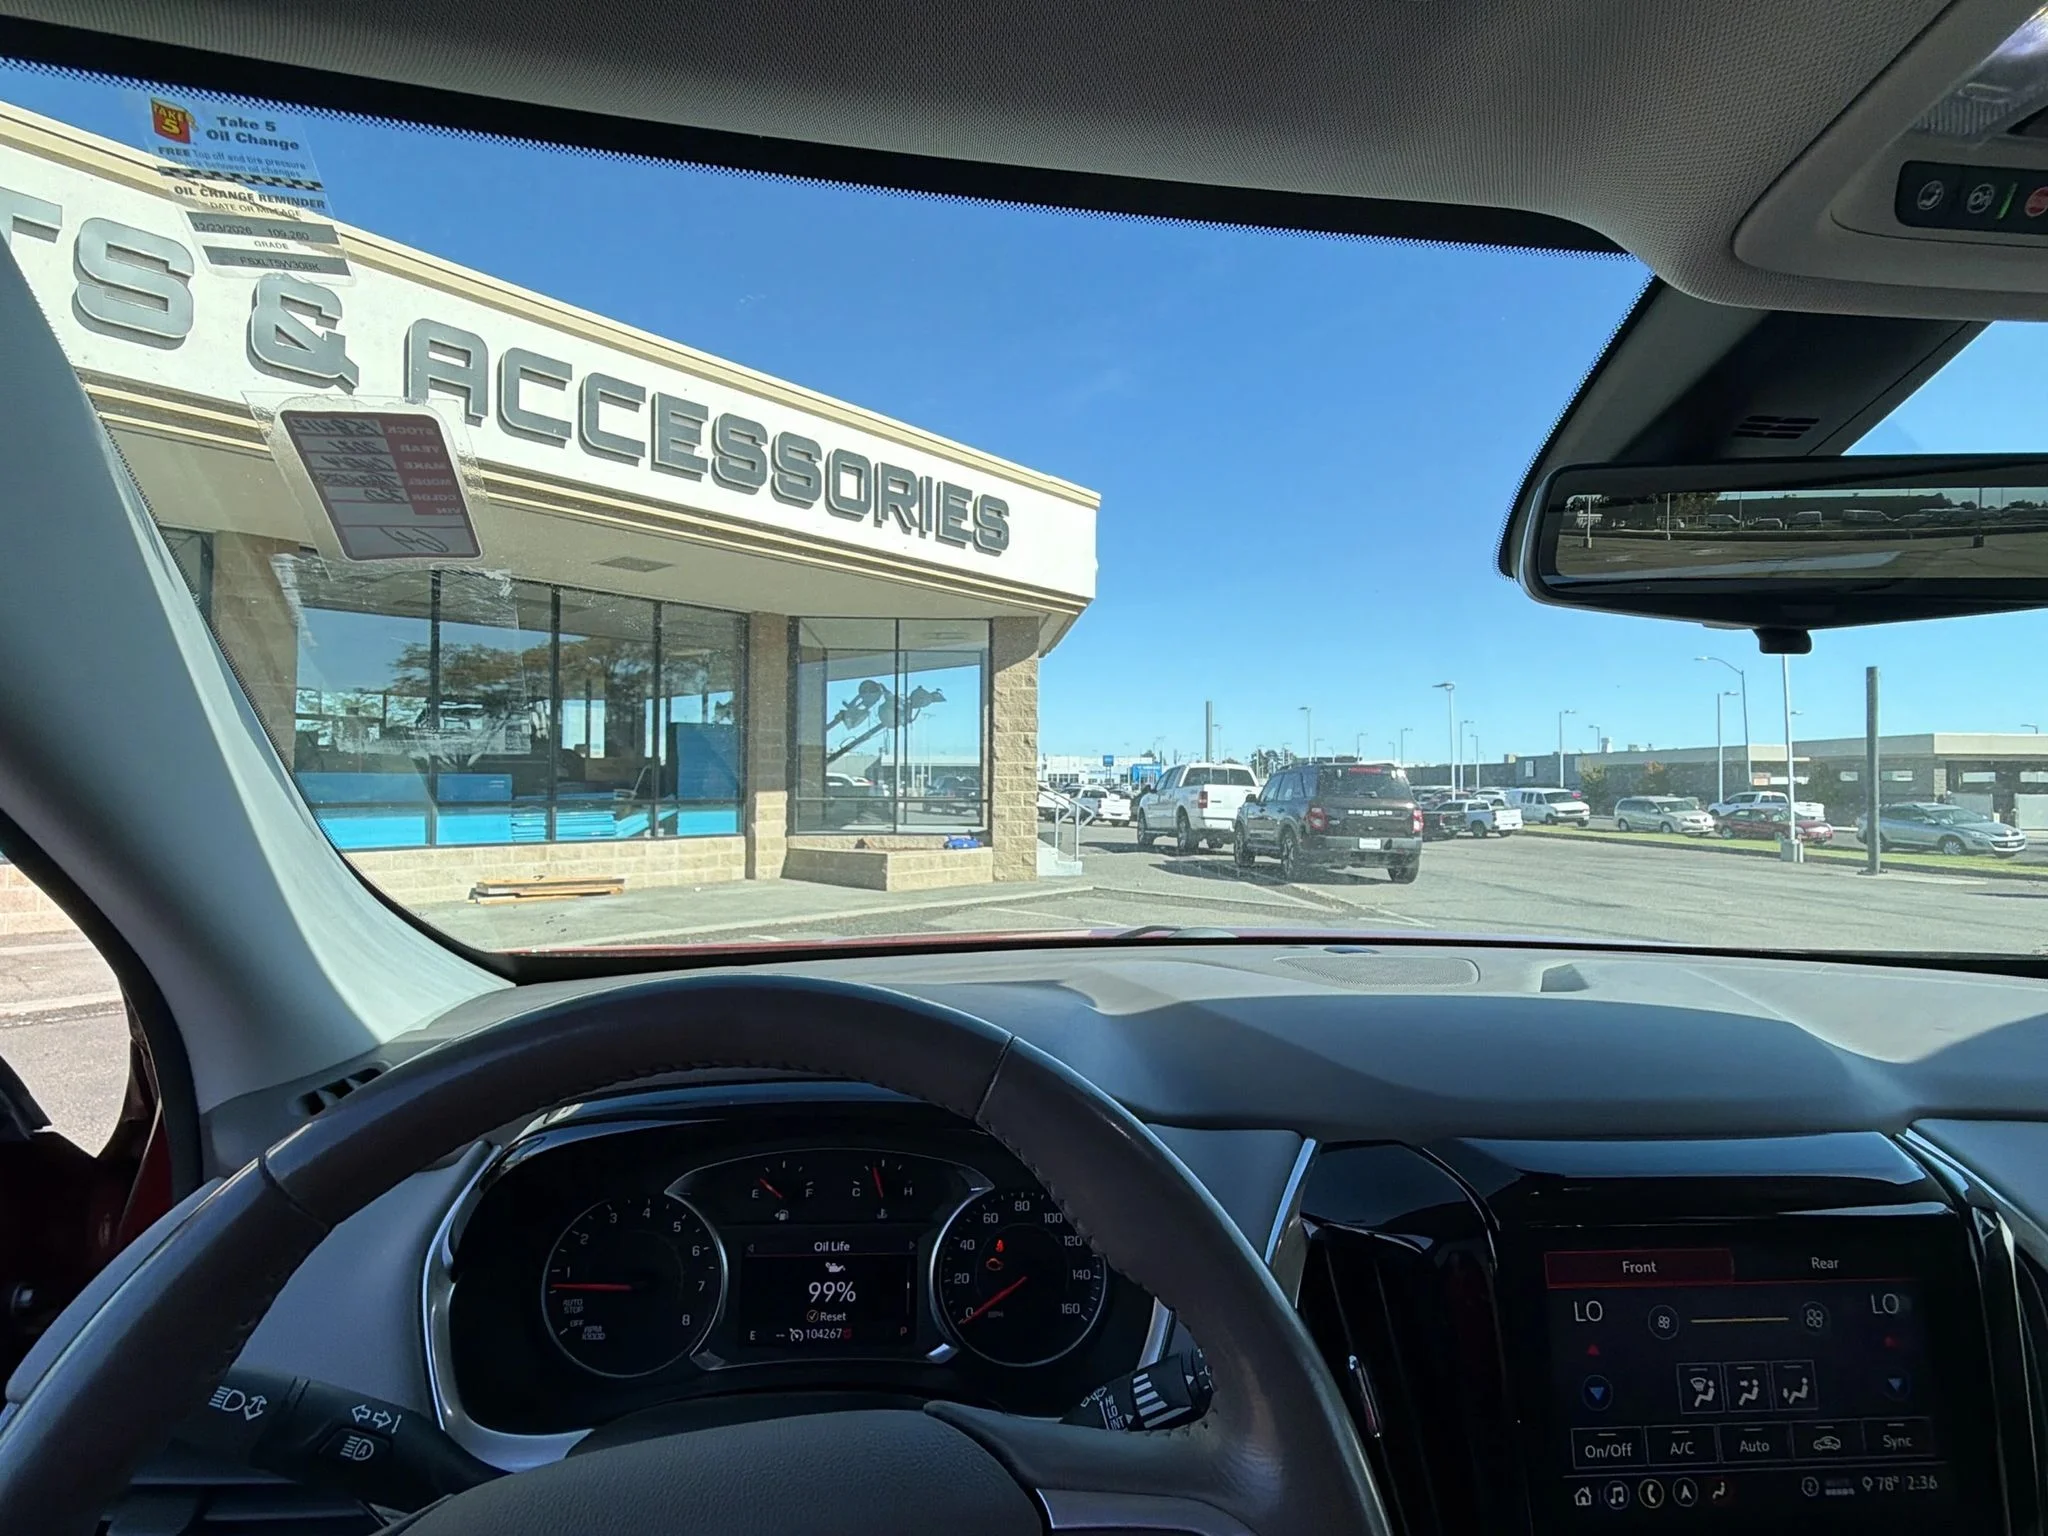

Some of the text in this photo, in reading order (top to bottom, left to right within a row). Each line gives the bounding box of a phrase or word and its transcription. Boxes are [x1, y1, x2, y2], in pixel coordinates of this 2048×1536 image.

[162, 118, 181, 135] 5
[216, 116, 276, 132] Take 5
[206, 129, 299, 151] Oil Change
[158, 147, 190, 157] FREE
[265, 158, 307, 170] pressure
[174, 186, 326, 209] OIL CHANGE REMINDER
[210, 202, 301, 218] DATE OR MILEAGE
[254, 240, 289, 250] GRADE
[248, 272, 359, 392] &
[404, 318, 1009, 557] ACCESSORIES
[752, 1189, 759, 1198] E
[805, 1188, 814, 1198] F
[852, 1188, 861, 1197] C
[904, 1187, 913, 1196] H
[1014, 1200, 1030, 1211] 80
[609, 1213, 618, 1223] 3
[642, 1208, 651, 1218] 4
[983, 1213, 999, 1224] 60
[1044, 1212, 1063, 1224] 100
[673, 1221, 681, 1232] 5
[580, 1234, 589, 1245] 2
[960, 1239, 975, 1250] 40
[1064, 1235, 1083, 1247] 120
[692, 1246, 700, 1257] 6
[814, 1241, 851, 1252] Oil Life
[1622, 1260, 1657, 1274] Front
[1811, 1256, 1840, 1271] Rear
[954, 1273, 970, 1284] 20
[1072, 1269, 1091, 1280] 140
[698, 1280, 705, 1292] 7
[808, 1281, 857, 1303] 99%
[1061, 1303, 1081, 1314] 160
[1871, 1293, 1900, 1315] LO
[820, 1312, 847, 1322] Reset
[965, 1307, 973, 1318] 0
[1573, 1300, 1604, 1323] LO
[682, 1314, 690, 1326] 8
[750, 1331, 756, 1341] E
[805, 1328, 843, 1339] 104267
[1105, 1394, 1114, 1405] HI
[1107, 1405, 1119, 1417] LO
[1110, 1416, 1125, 1430] INT
[1739, 1439, 1770, 1453] Auto
[1883, 1434, 1913, 1450] Sync
[1585, 1443, 1633, 1459] On/Off
[1669, 1441, 1696, 1456] A/C
[1906, 1475, 1938, 1491] 2:36
